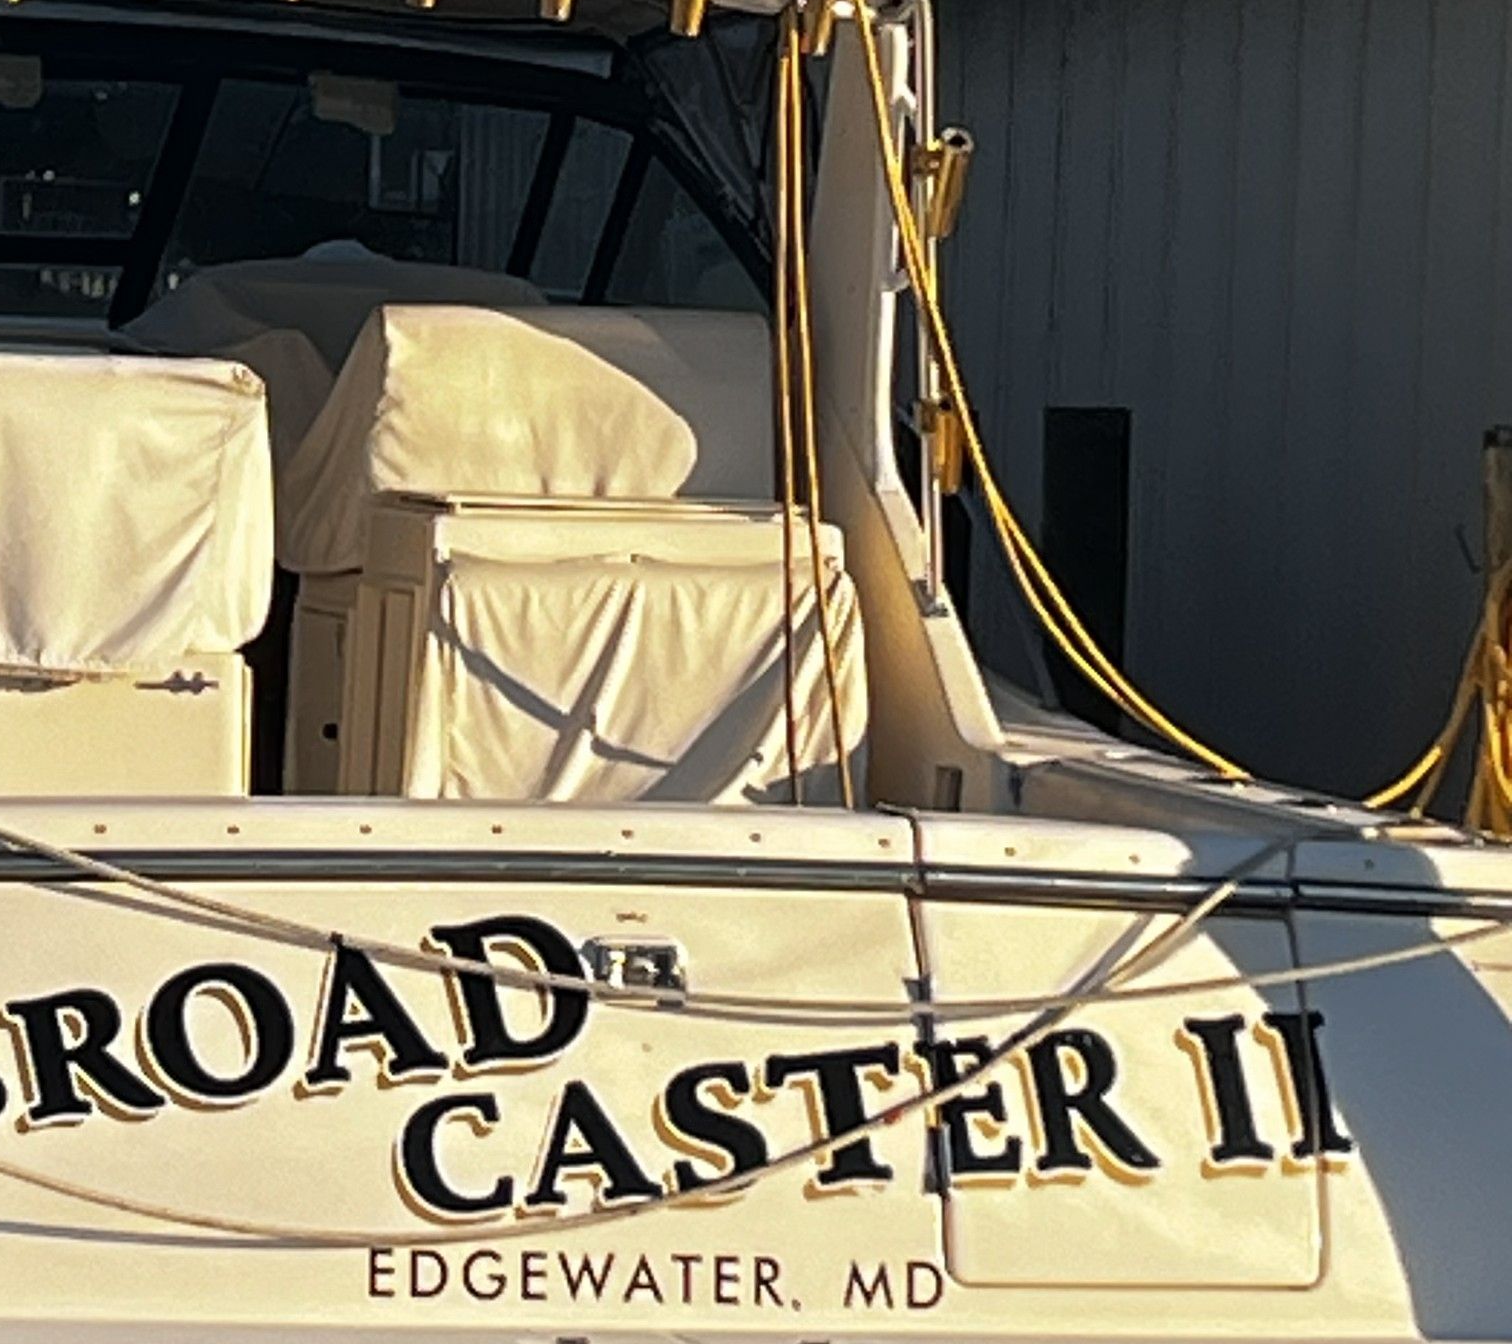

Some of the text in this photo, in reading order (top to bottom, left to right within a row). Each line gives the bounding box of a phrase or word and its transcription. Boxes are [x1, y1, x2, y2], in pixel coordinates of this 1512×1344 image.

[390, 1009, 1355, 1224] CASTER II
[843, 1259, 946, 1311] MD
